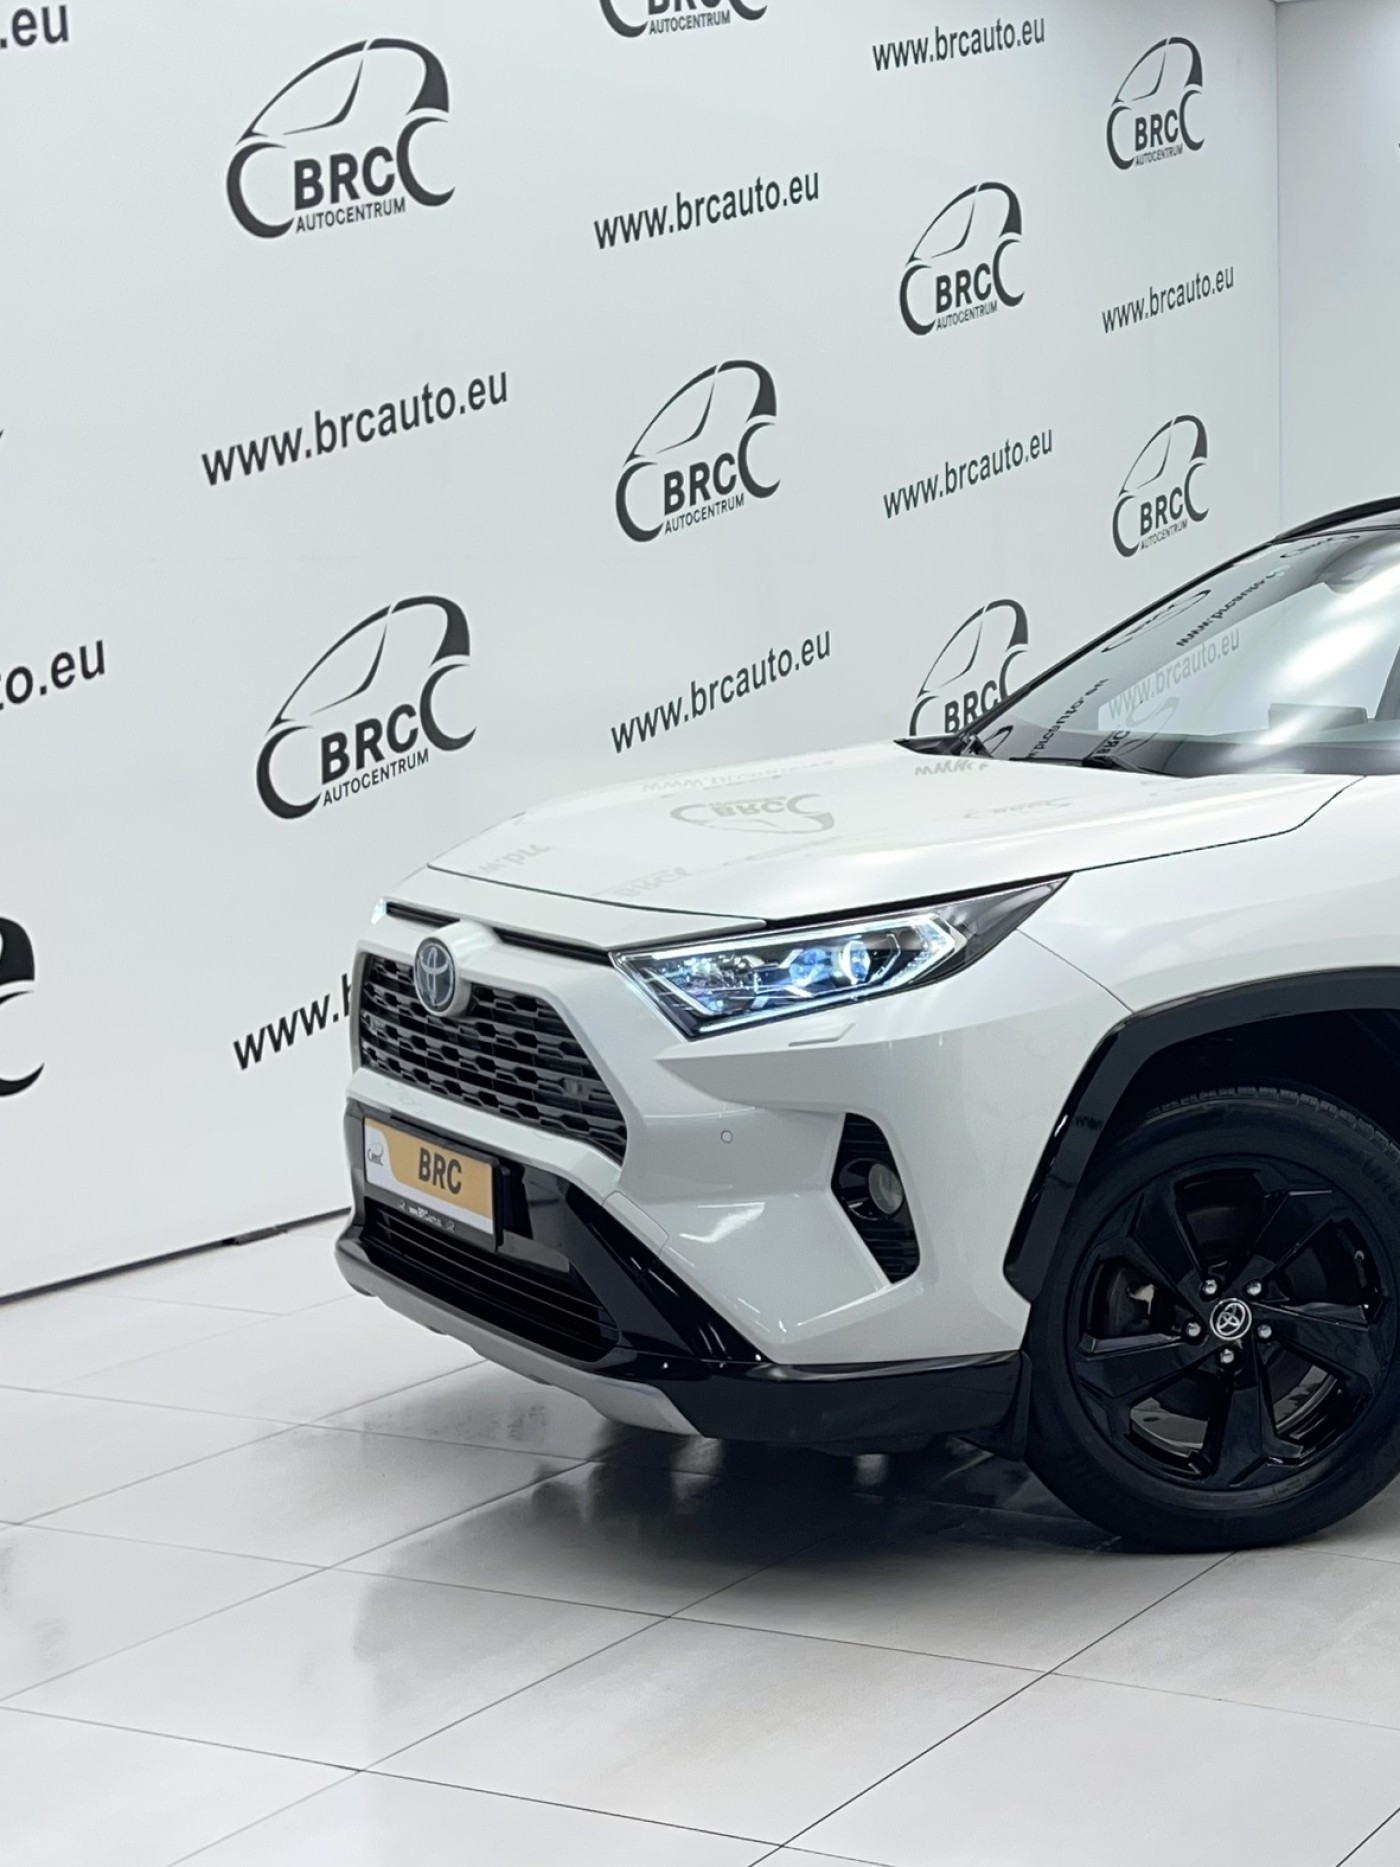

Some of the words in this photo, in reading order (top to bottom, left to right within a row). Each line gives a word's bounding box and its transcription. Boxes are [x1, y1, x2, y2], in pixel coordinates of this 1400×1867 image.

[649, 10, 730, 35] AUTOCENTRUM
[873, 18, 1045, 71] www.brcauto.eu
[1135, 108, 1178, 153] BRC
[1136, 145, 1183, 166] AUTOCENTRUM
[294, 146, 395, 211] BRC
[295, 197, 405, 233] AUTOCENTRUM
[594, 173, 819, 249] www.brcauto.eu
[936, 263, 992, 314] BRC
[1102, 266, 1233, 333] www.brcauto.eu
[937, 301, 997, 330] AUTOCENTRUM
[202, 372, 508, 485] www.brcauto.eu
[664, 452, 738, 516] BRC
[884, 430, 1052, 518] www.brcauto.eu
[665, 493, 744, 535] AUTOCENTRUM
[1140, 487, 1183, 537] BRC
[1141, 519, 1188, 550] AUTOCENTRUM
[0, 640, 104, 711] o.eu
[611, 631, 831, 753] www.brcauto.eu
[320, 704, 419, 784] BRC
[322, 748, 429, 806] AUTOCENTRUM
[419, 1147, 462, 1195] BRC
